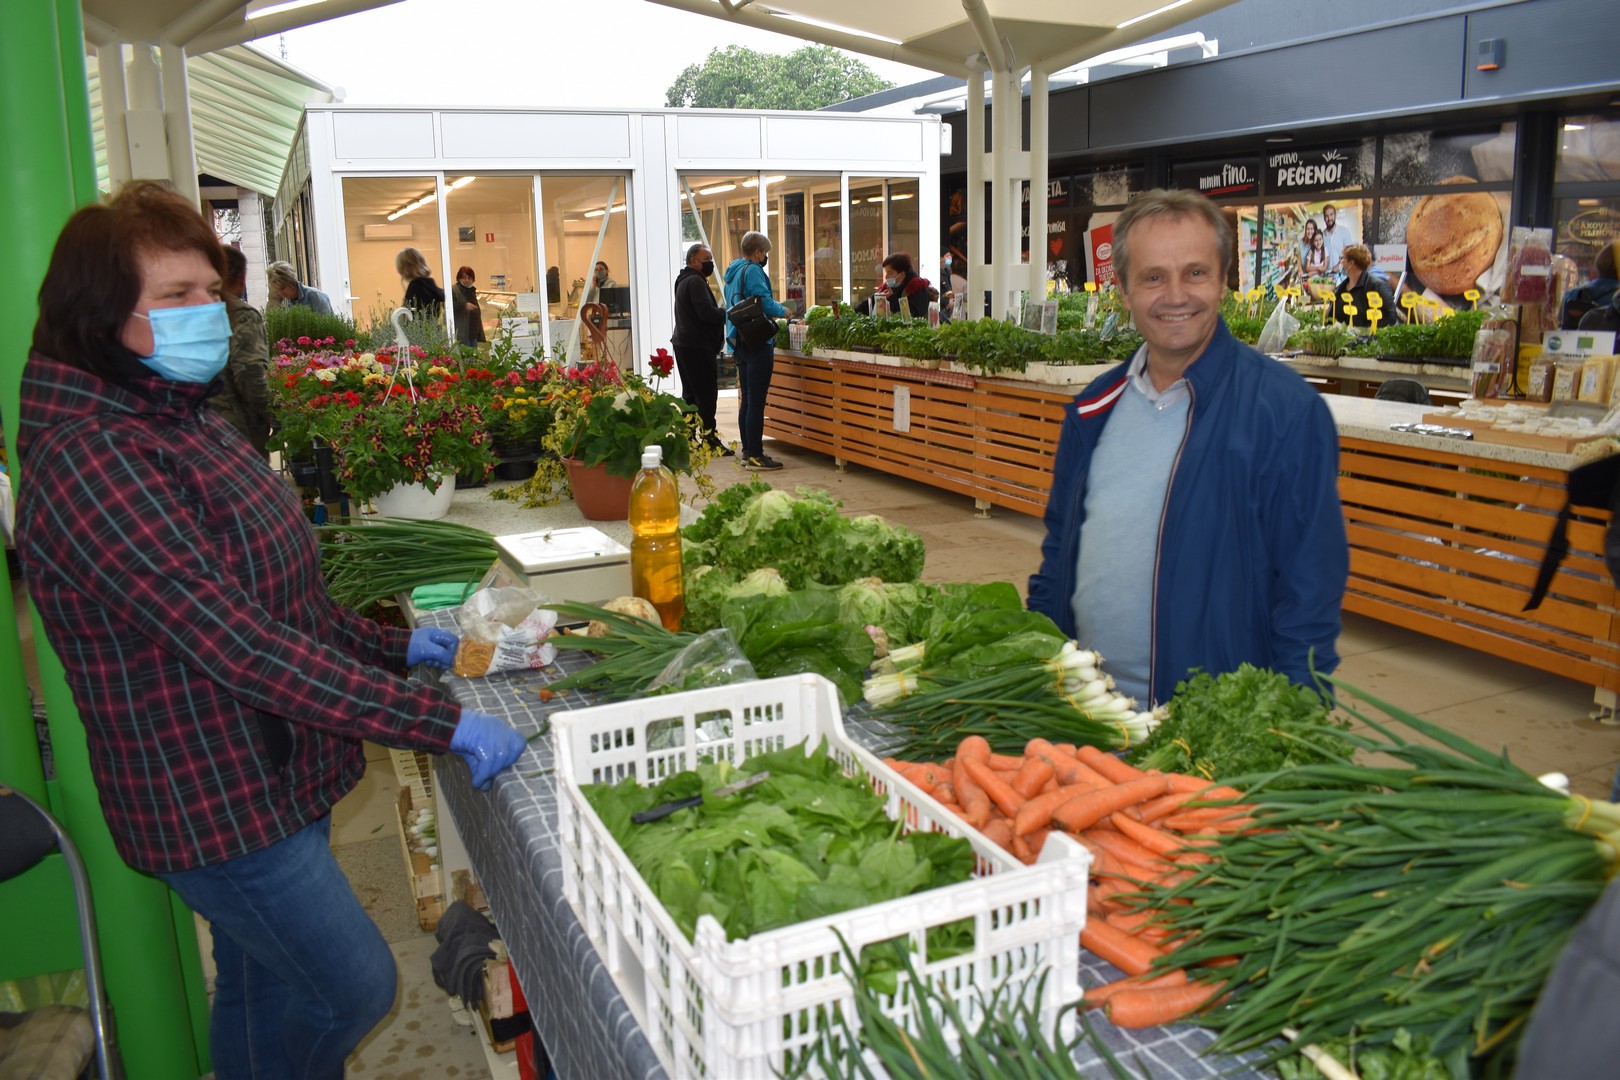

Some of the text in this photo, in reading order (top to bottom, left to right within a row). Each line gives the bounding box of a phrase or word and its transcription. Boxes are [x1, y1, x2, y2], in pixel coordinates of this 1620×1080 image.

[1269, 152, 1298, 168] upravo
[1277, 160, 1343, 187] PEČENO!
[1199, 163, 1255, 190] mmm fino...
